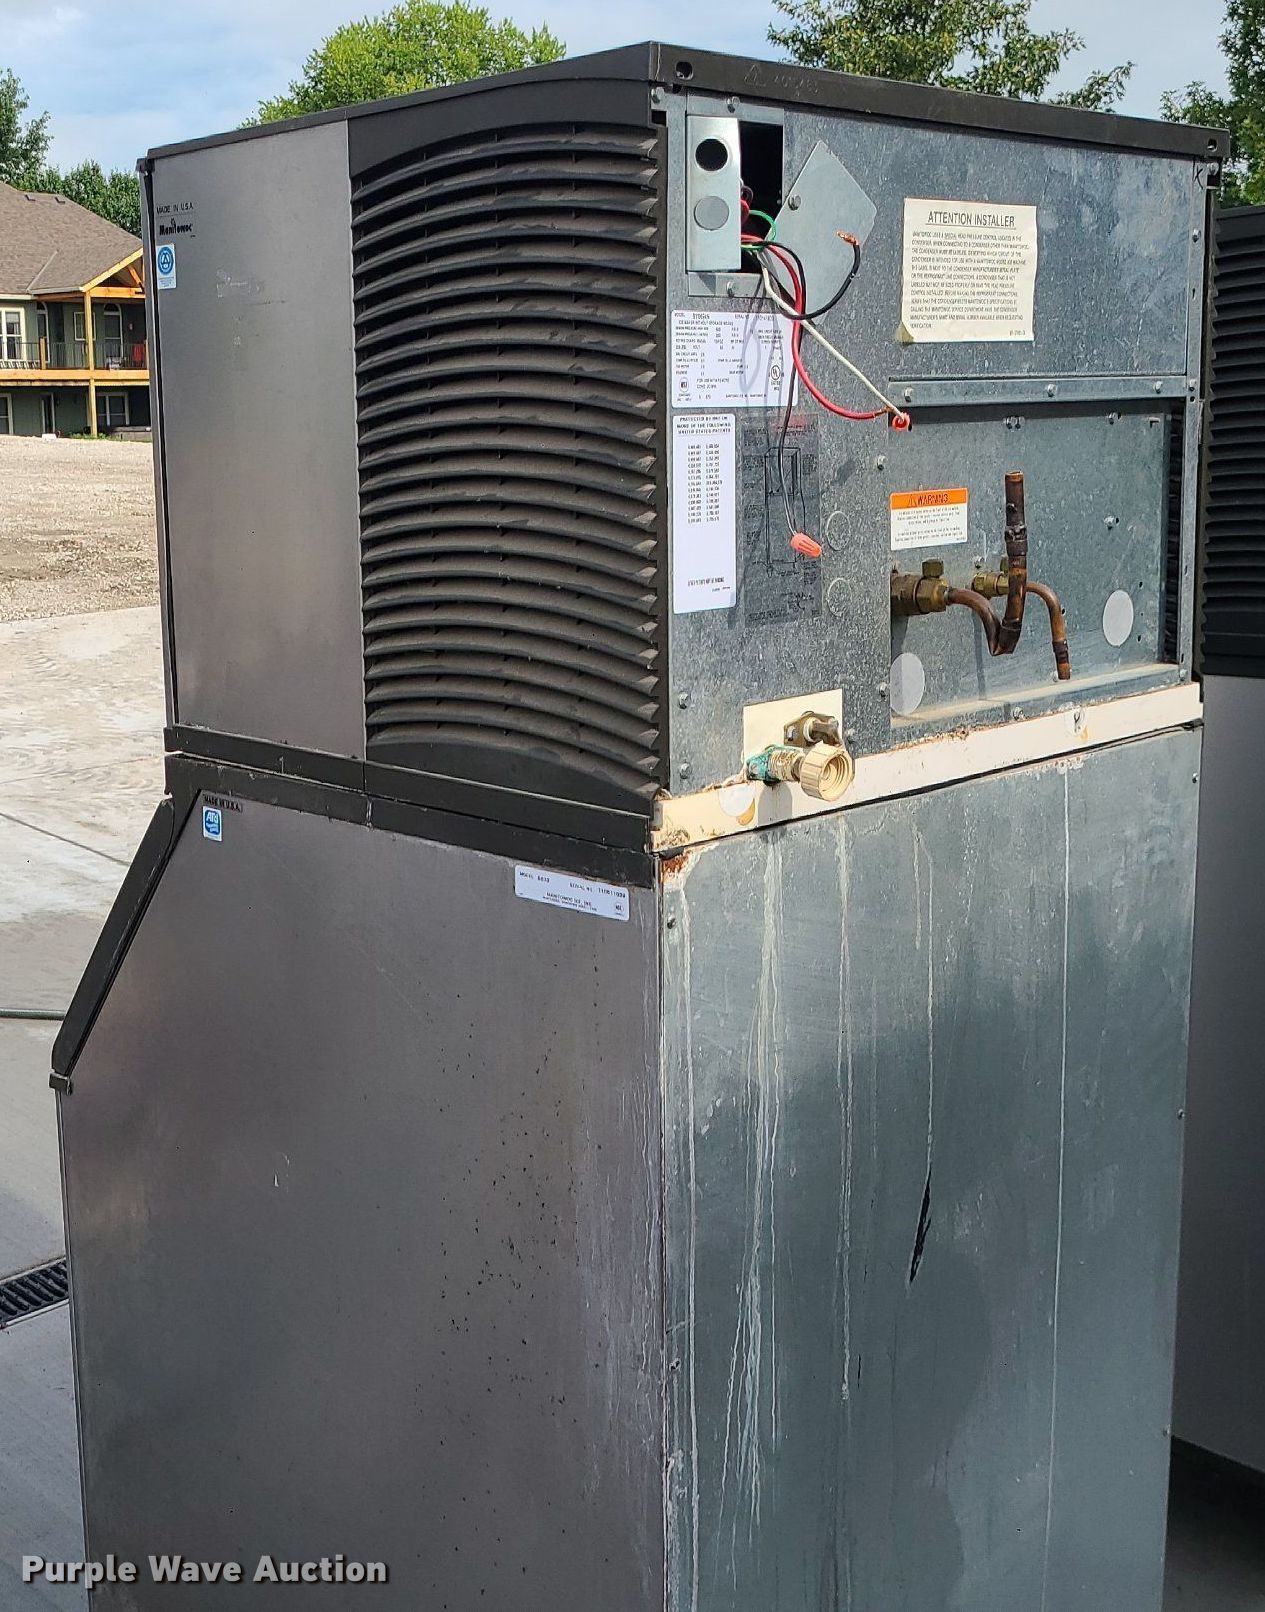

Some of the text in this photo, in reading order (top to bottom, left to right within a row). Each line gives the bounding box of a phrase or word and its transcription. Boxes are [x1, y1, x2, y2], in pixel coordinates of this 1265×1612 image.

[156, 205, 171, 214] MADE
[172, 204, 179, 212] IN
[927, 210, 1015, 227] ATTENTION INSTALLER
[917, 493, 949, 506] WARNING
